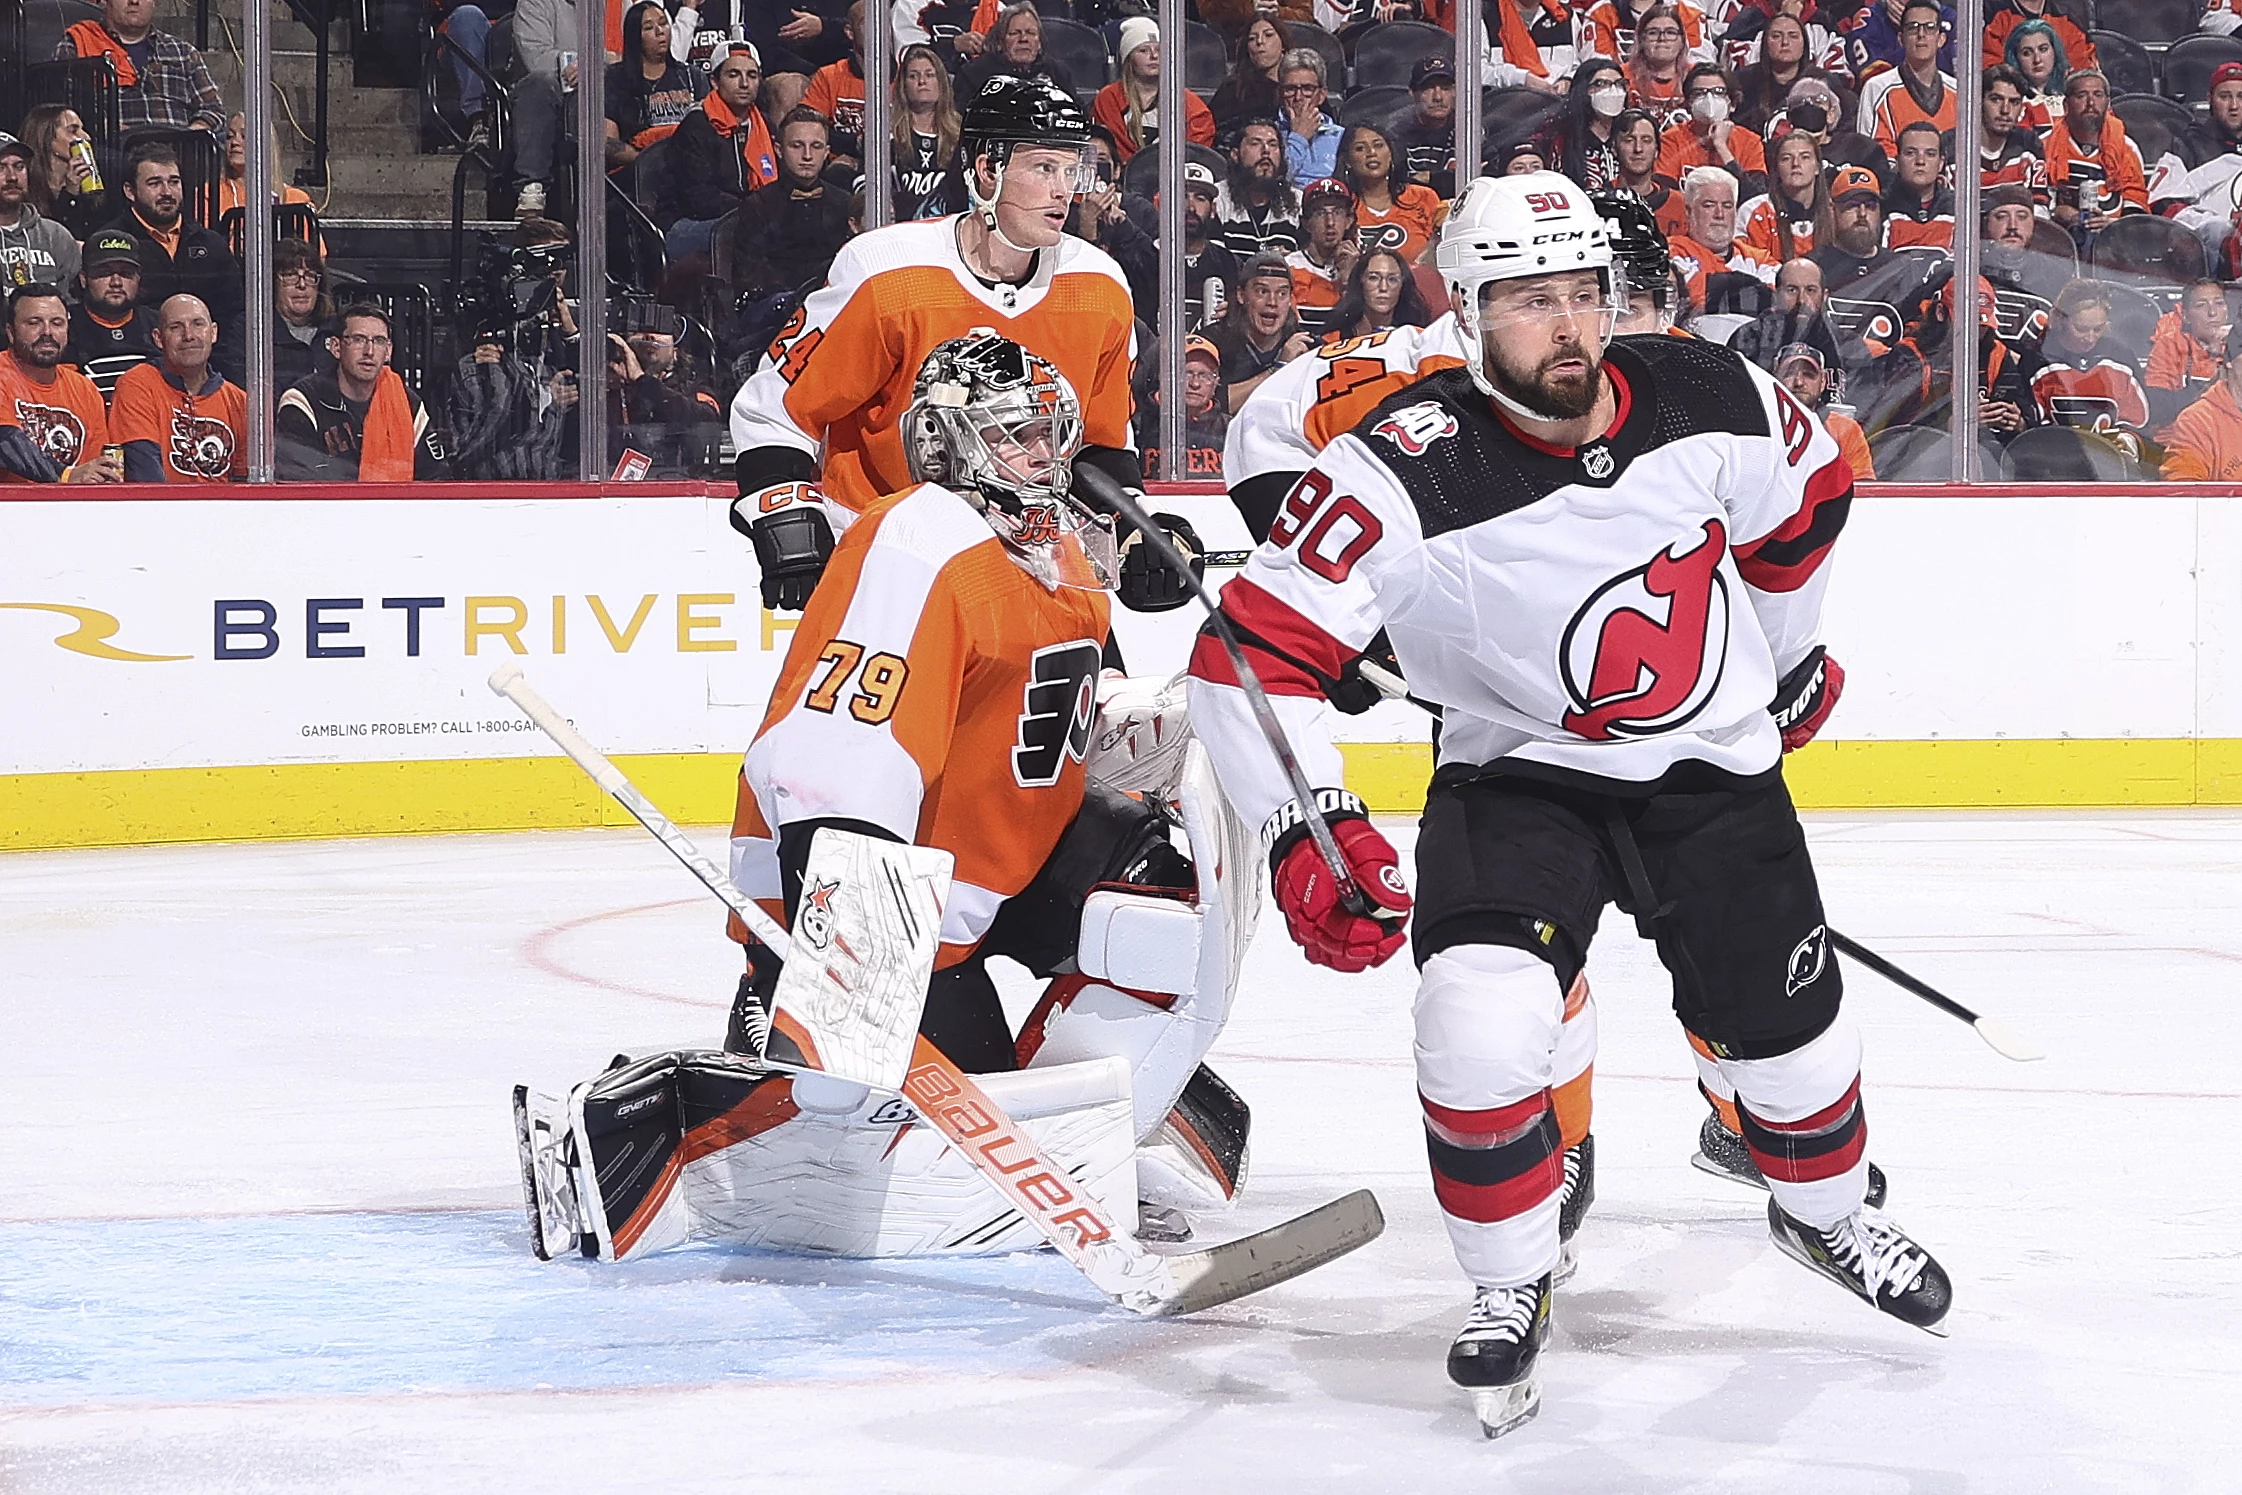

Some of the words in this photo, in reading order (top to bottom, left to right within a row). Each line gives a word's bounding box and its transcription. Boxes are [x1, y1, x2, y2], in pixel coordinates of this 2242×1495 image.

[1055, 119, 1084, 129] CCM
[1532, 230, 1585, 246] CCM
[1268, 466, 1384, 585] 90
[803, 639, 911, 727] 79
[301, 723, 368, 738] GAMBLING
[371, 721, 437, 736] PROBLEM?
[441, 720, 473, 734] CALL
